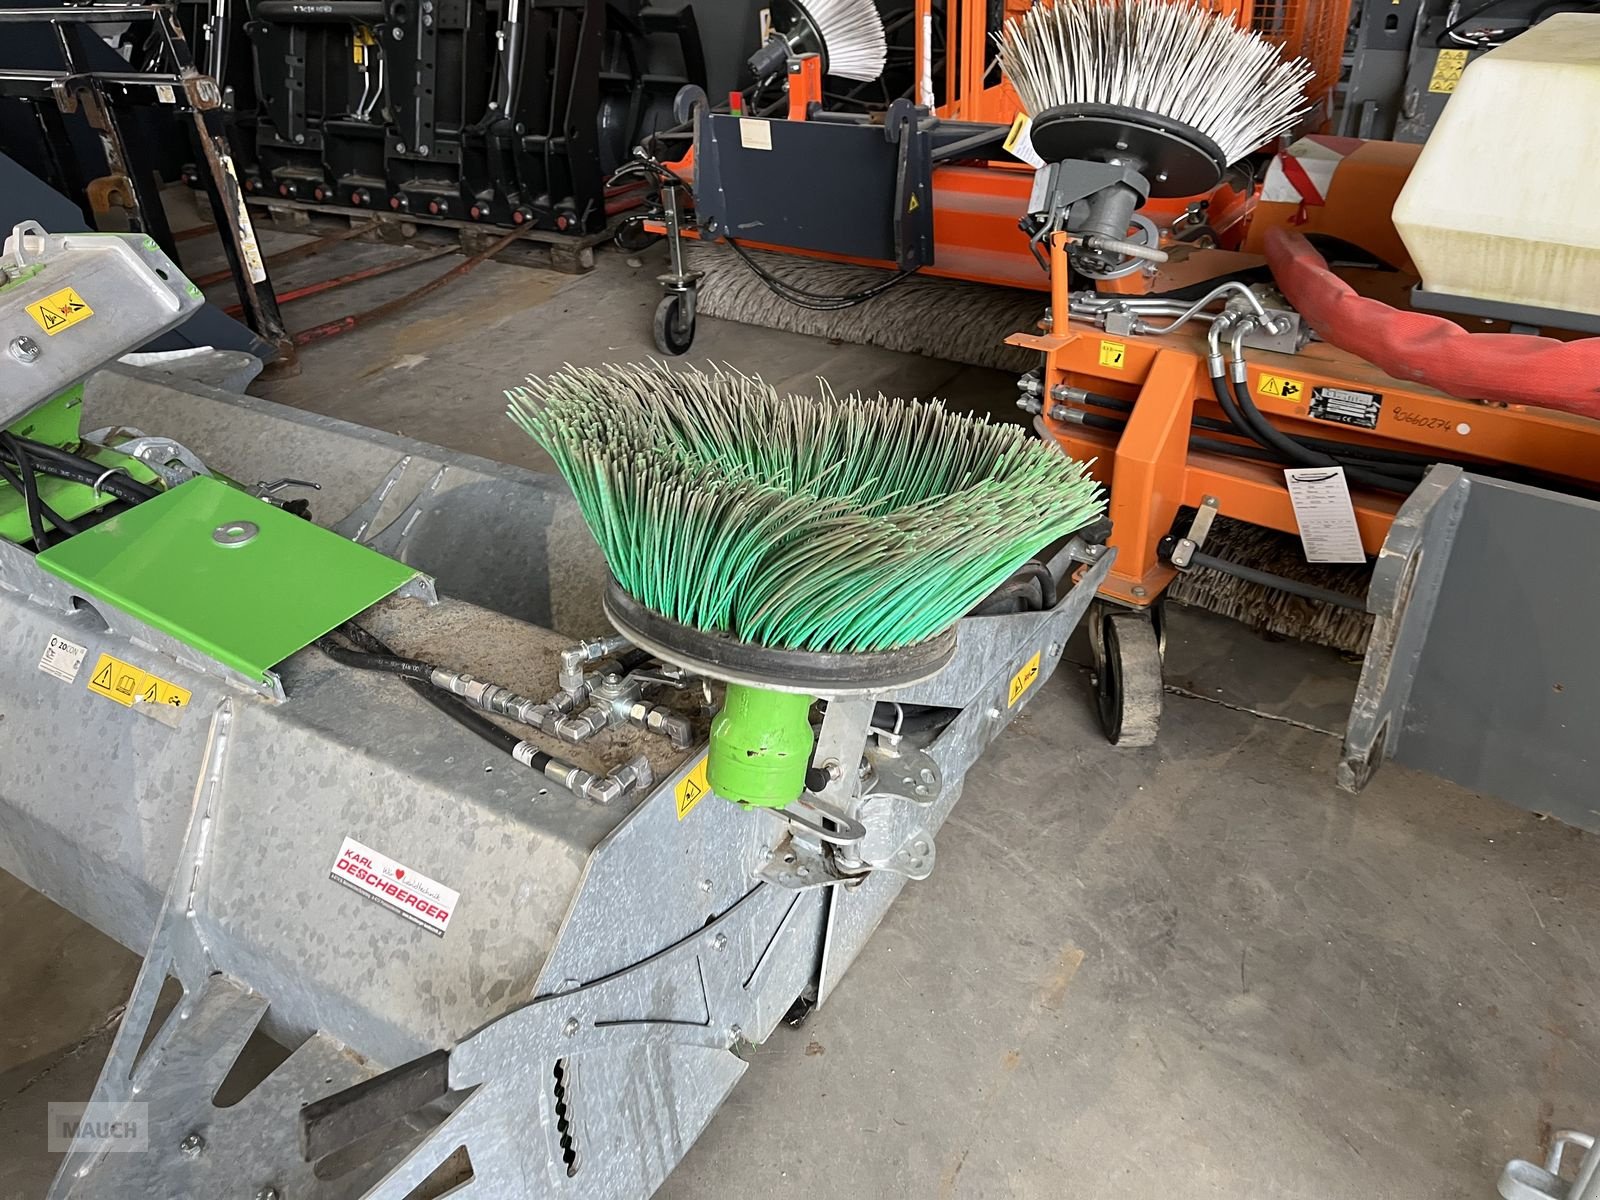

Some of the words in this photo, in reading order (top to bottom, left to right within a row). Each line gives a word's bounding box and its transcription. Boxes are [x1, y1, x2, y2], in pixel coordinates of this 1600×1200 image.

[1393, 406, 1451, 431] 90660274
[344, 849, 373, 870] KARL
[336, 858, 449, 923] DESCHBERGER
